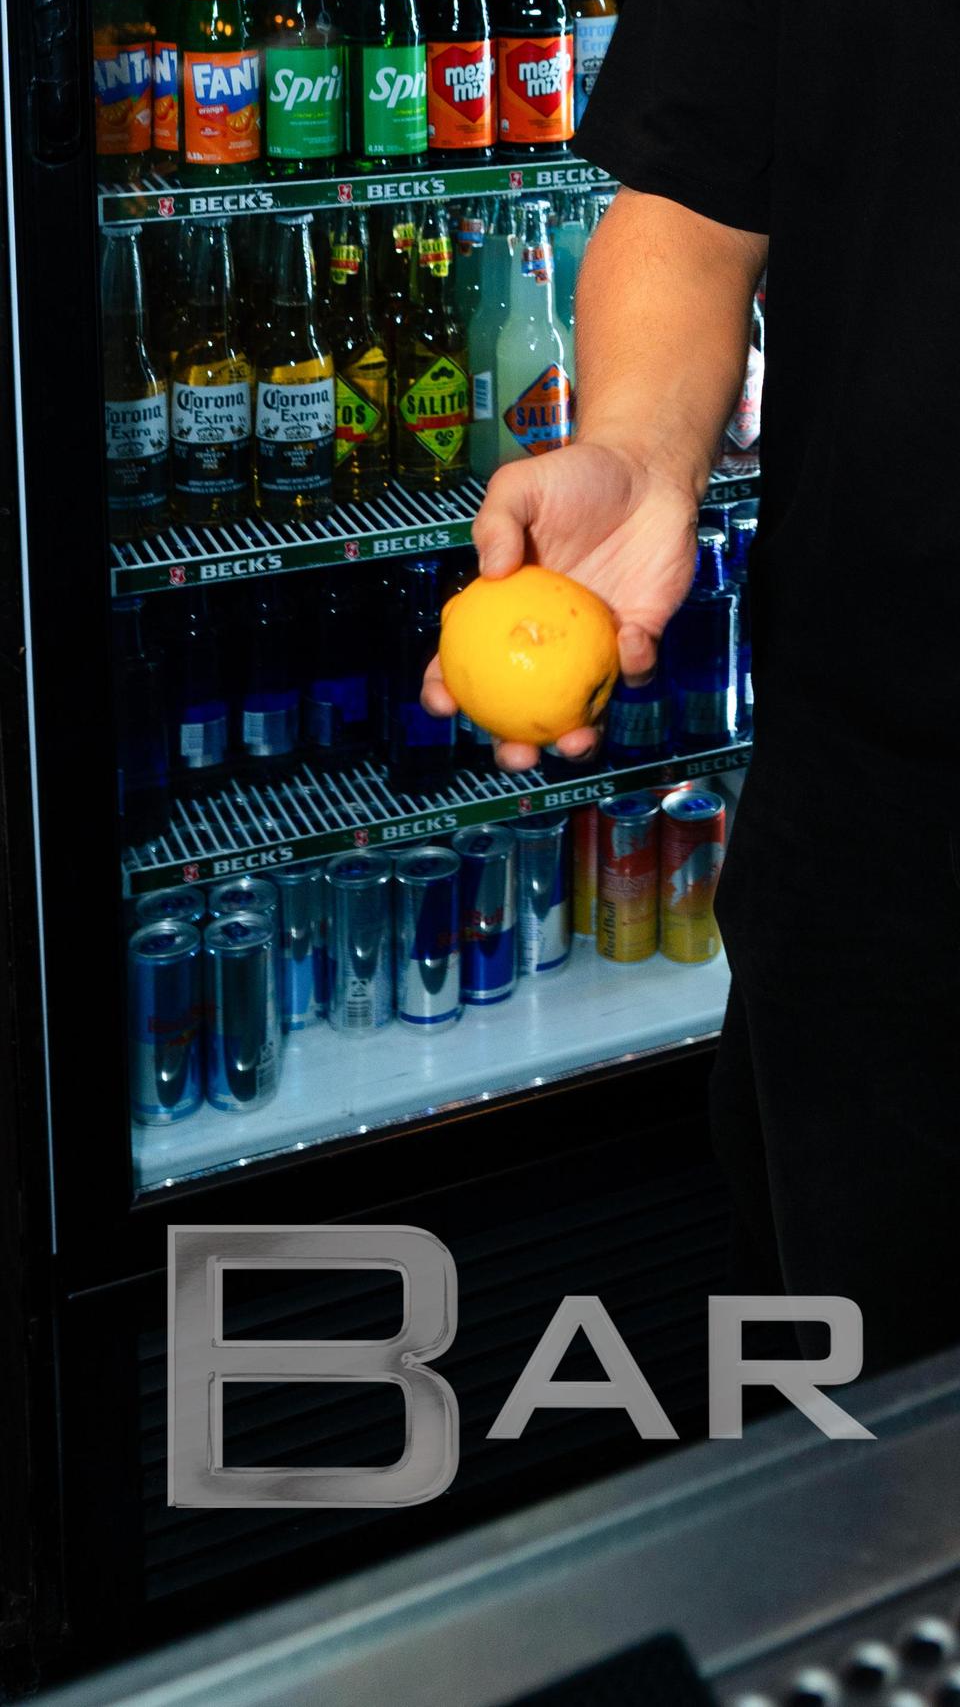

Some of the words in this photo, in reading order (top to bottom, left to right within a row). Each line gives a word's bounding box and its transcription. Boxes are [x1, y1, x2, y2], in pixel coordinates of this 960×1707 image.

[192, 56, 259, 101] FANT
[189, 192, 274, 214] BECK'S
[366, 177, 446, 200] BECK'S
[536, 166, 611, 187] BECK'S
[176, 388, 246, 414] Corona
[263, 387, 331, 414] Corona
[406, 390, 466, 416] SALITO
[194, 409, 234, 427] Extra
[280, 408, 320, 426] Extra
[199, 553, 283, 581] BECK'S
[372, 528, 451, 556] BECK'S
[703, 481, 752, 503] CK'S
[212, 844, 294, 877] BECK'S
[381, 811, 459, 842] BECK'S
[543, 778, 617, 808] BECK'S
